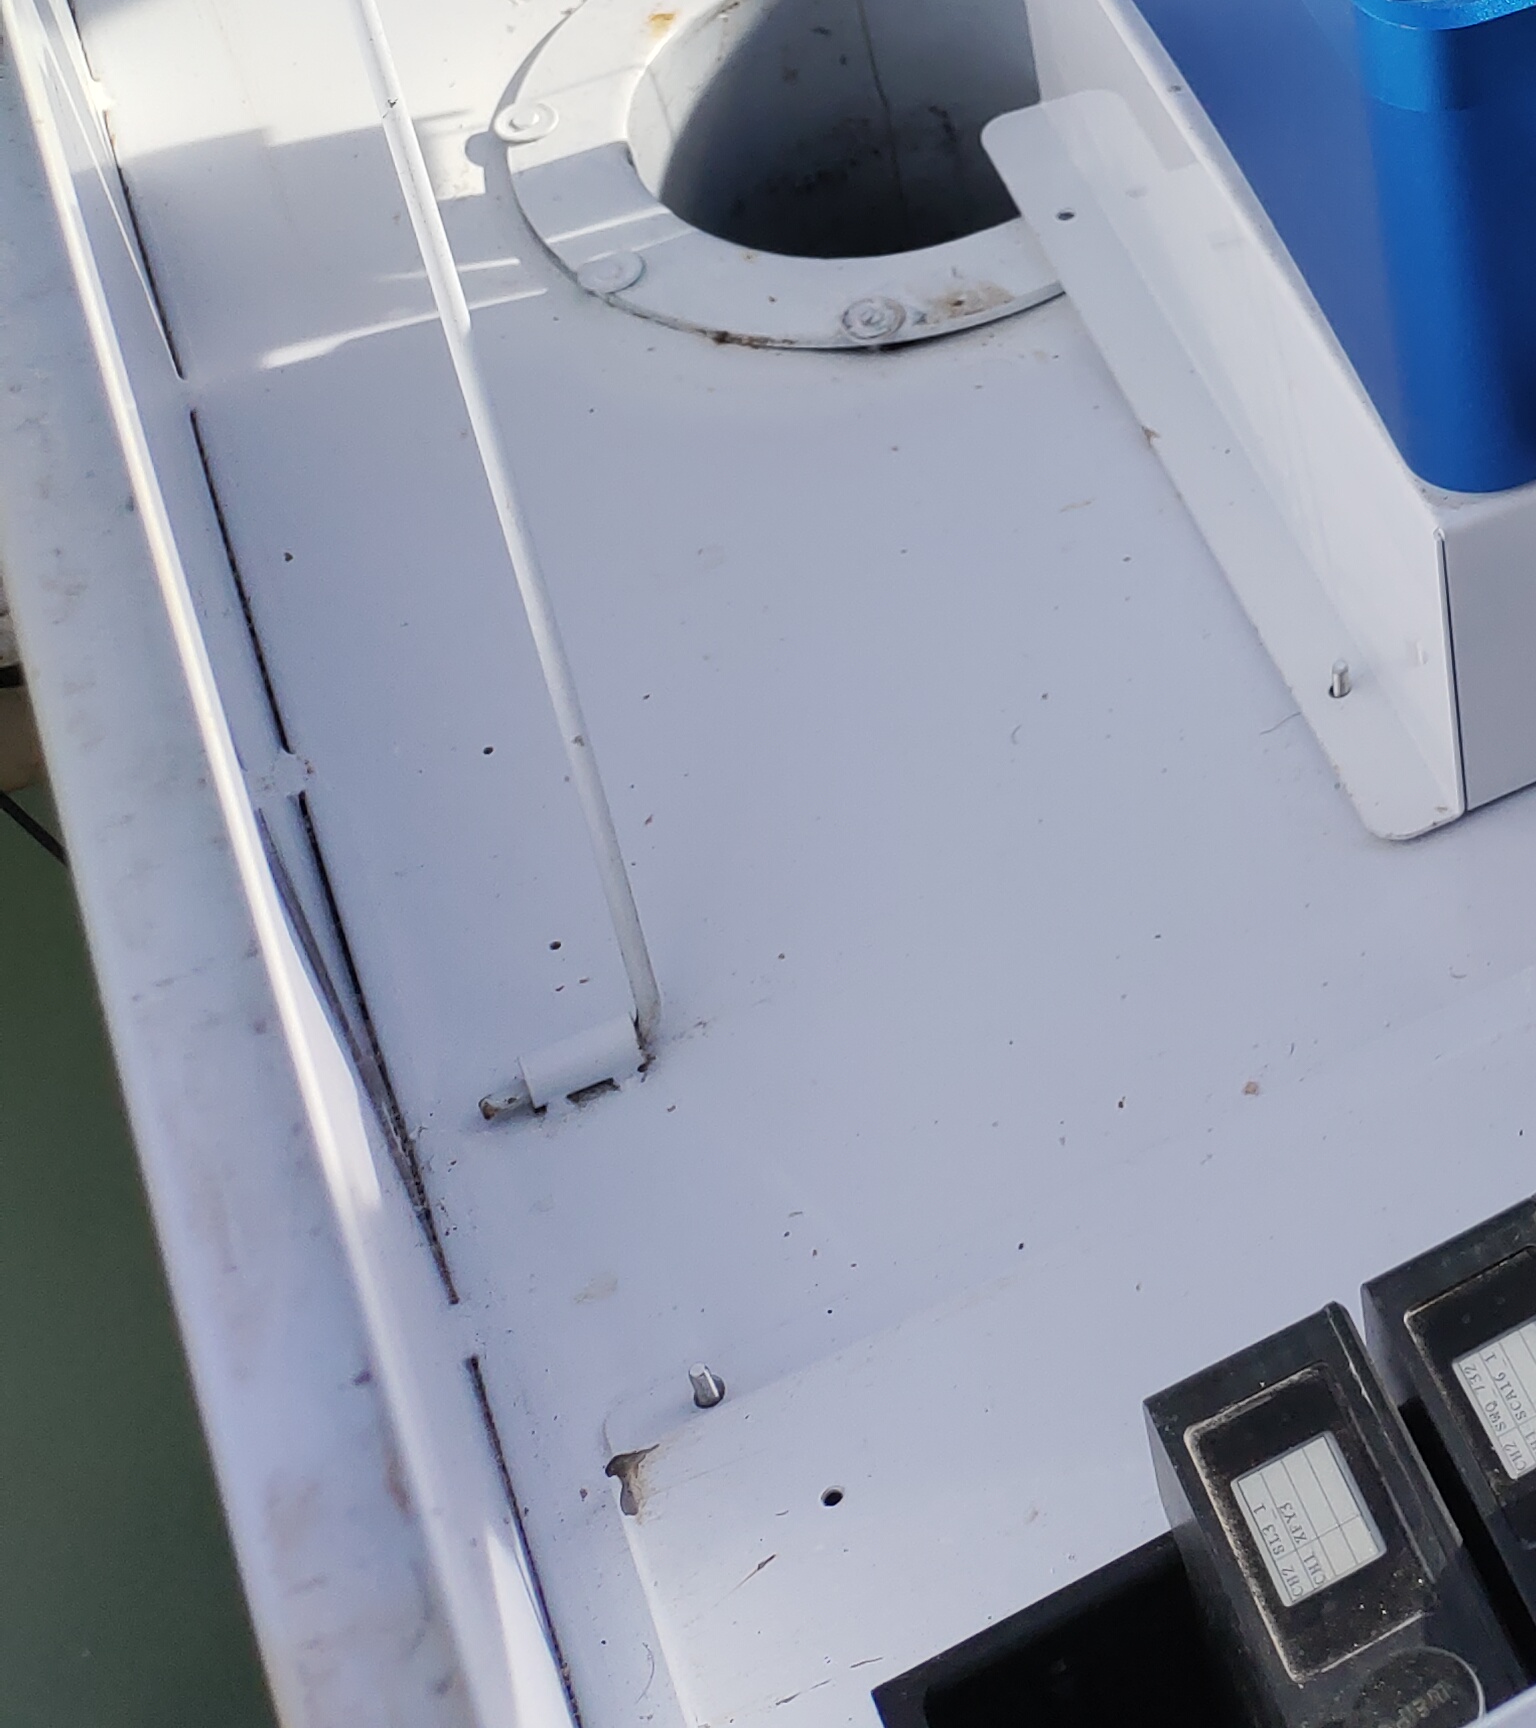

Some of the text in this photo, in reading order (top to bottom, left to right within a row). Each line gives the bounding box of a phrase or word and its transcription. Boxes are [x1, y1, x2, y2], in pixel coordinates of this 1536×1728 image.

[1485, 1353, 1527, 1421] SCA16_1
[1464, 1363, 1527, 1471] CH2 SWQ_732
[1281, 1565, 1304, 1597] CH2
[1303, 1554, 1327, 1585] CH1
